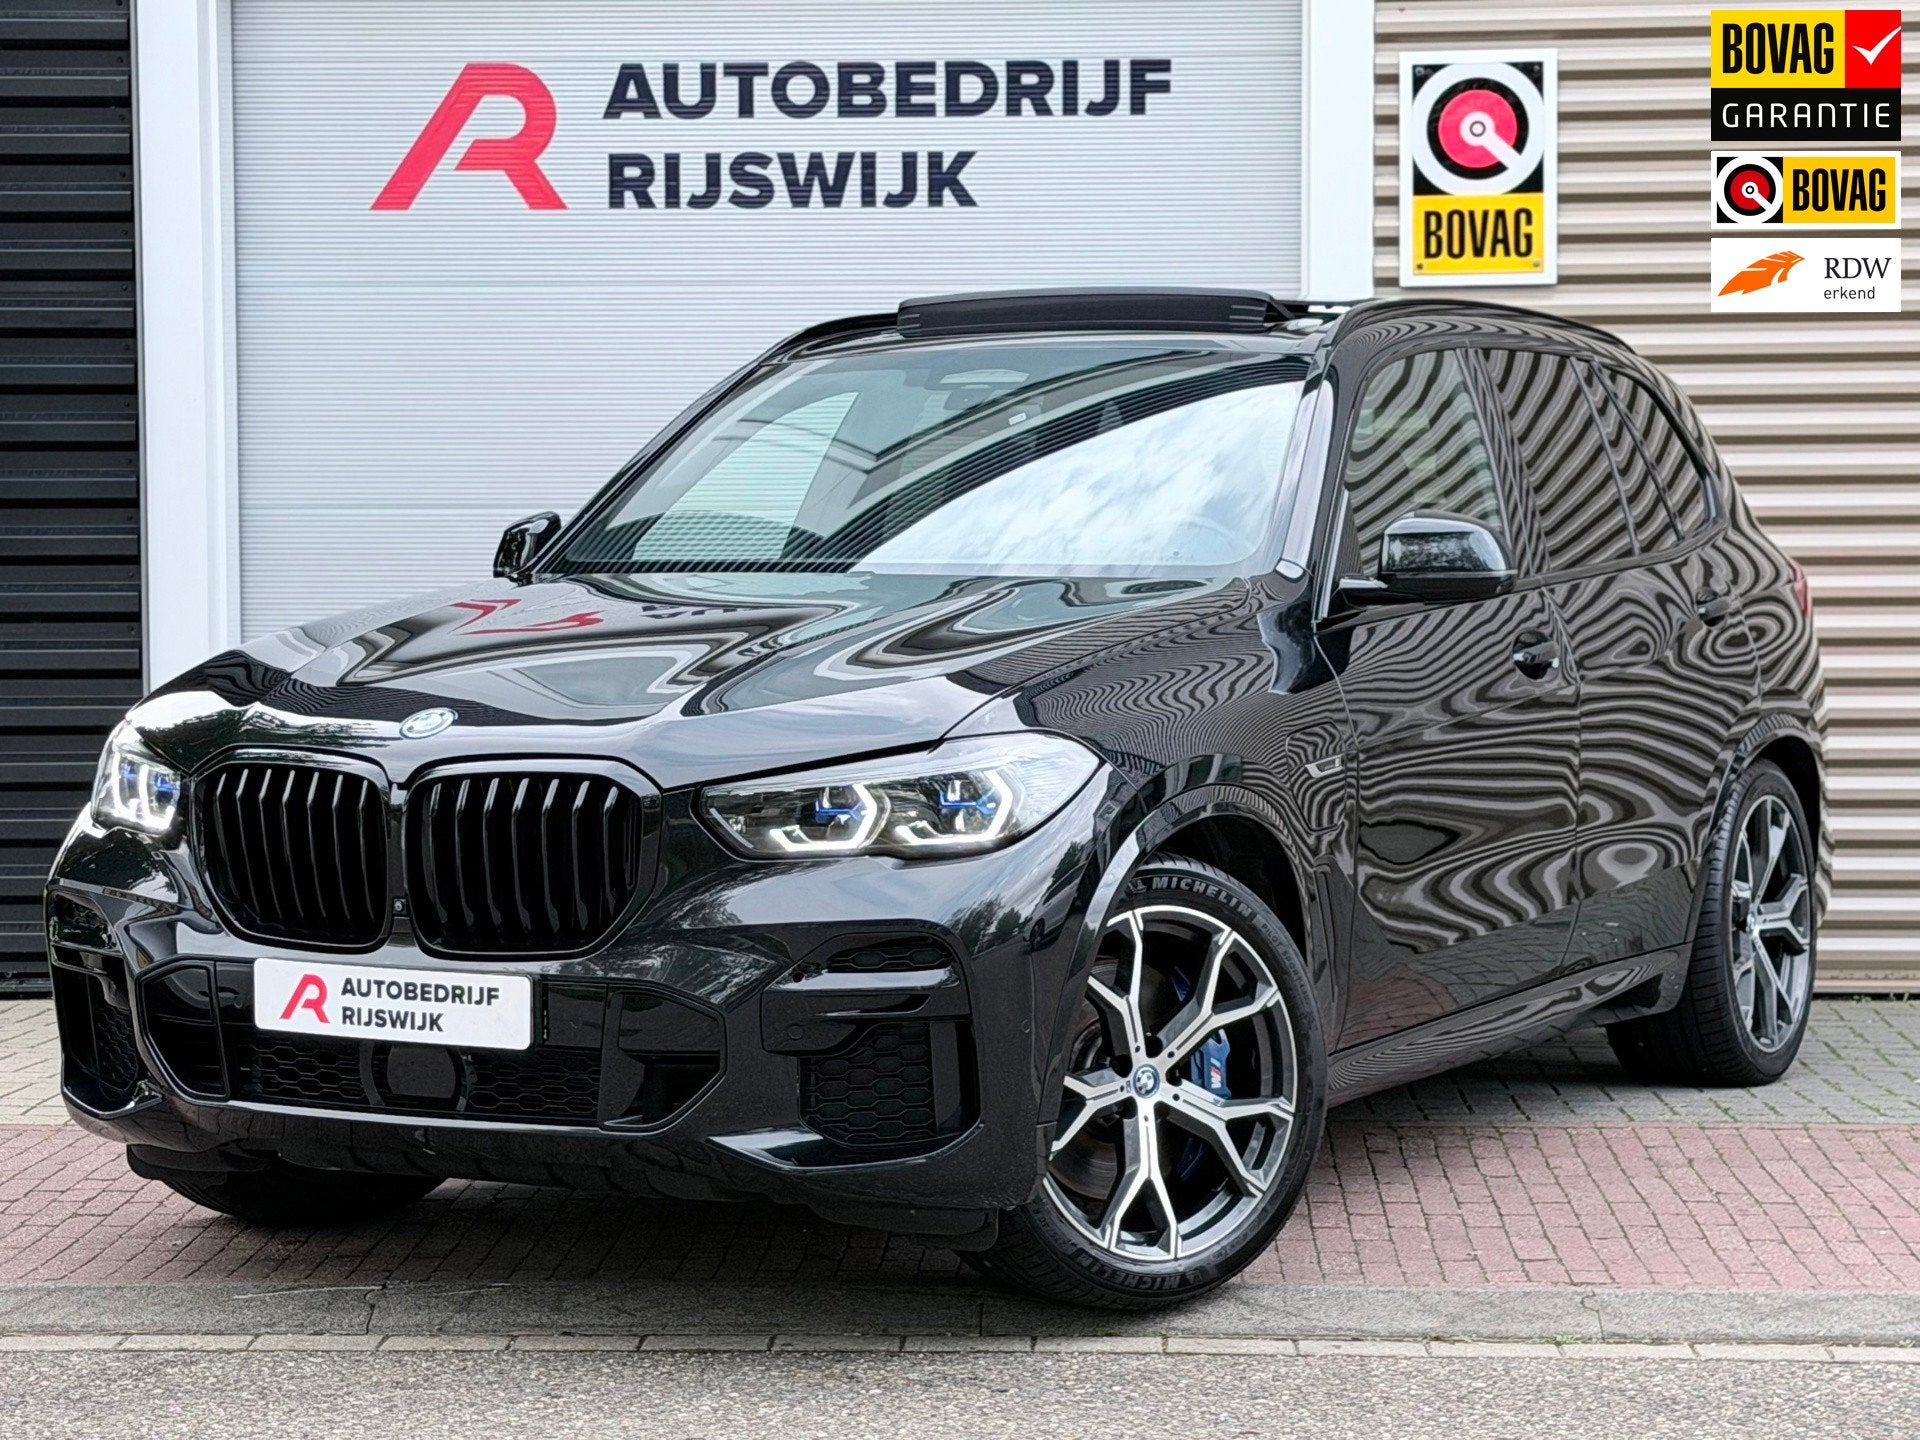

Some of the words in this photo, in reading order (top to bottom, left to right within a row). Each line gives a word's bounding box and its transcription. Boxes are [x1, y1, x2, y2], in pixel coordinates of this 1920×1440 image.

[602, 59, 1172, 120] AUTOBEDRIJF
[608, 151, 979, 211] RIJSWIJK
[1423, 208, 1534, 260] BOVAG
[1151, 875, 1254, 918] MICHELIN
[1261, 923, 1283, 947] PILOT
[341, 977, 500, 1006] AUTOBEDRIJF
[341, 1006, 444, 1032] RIJSWIJK
[1072, 1249, 1182, 1290] MICHELIN
